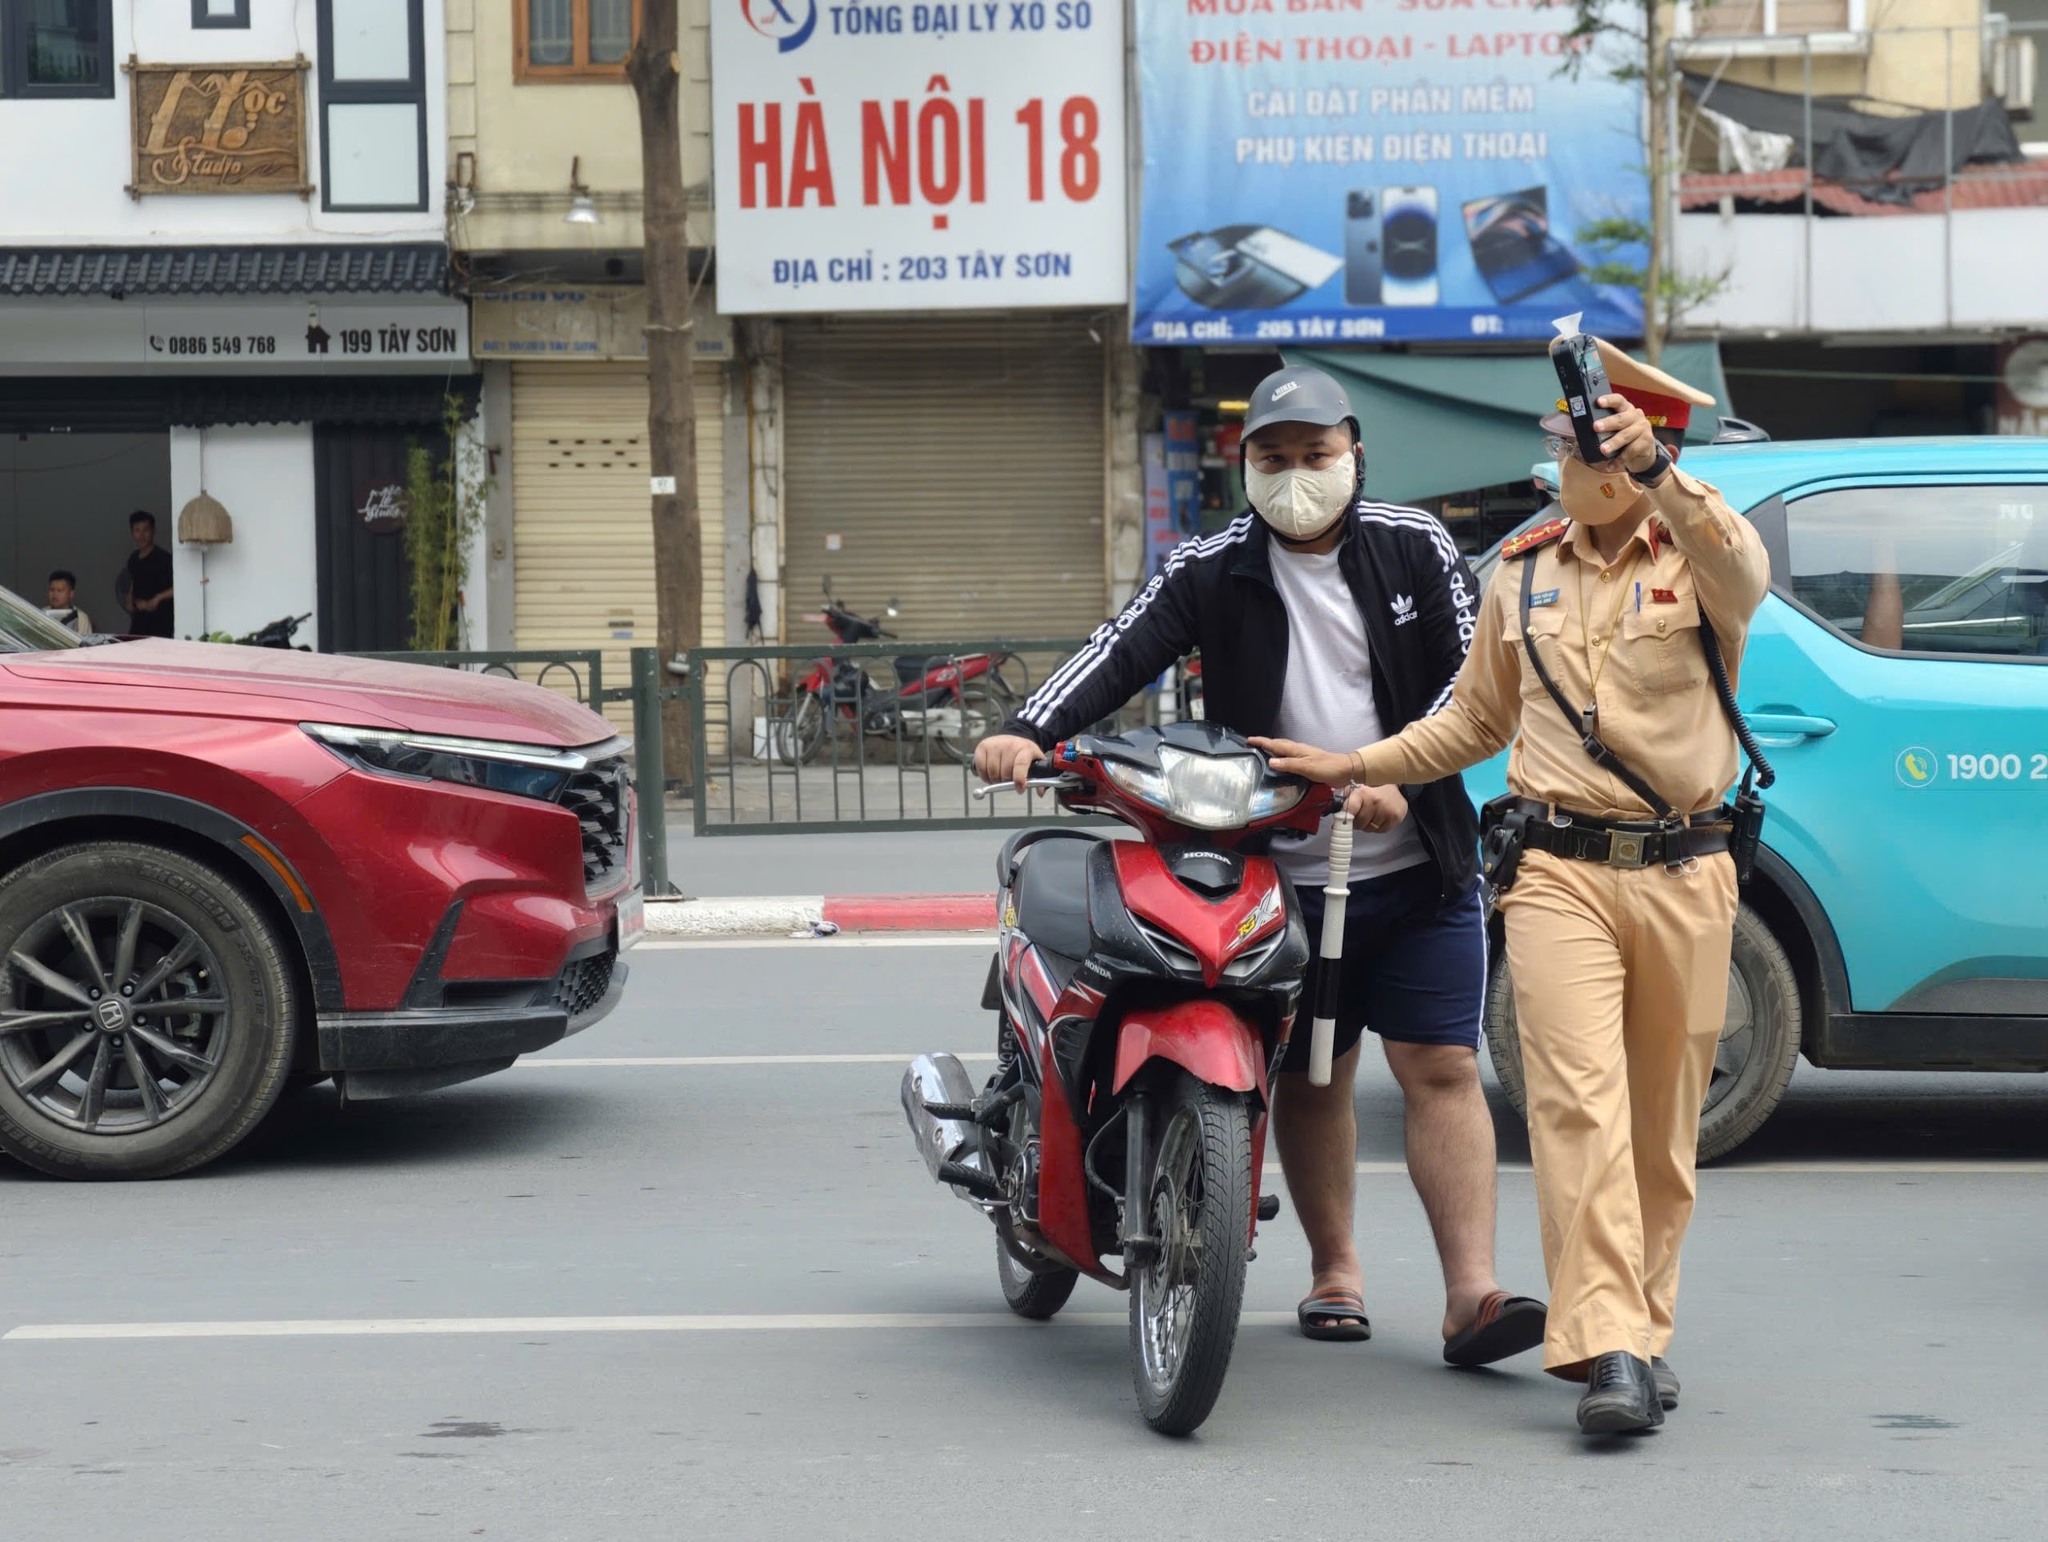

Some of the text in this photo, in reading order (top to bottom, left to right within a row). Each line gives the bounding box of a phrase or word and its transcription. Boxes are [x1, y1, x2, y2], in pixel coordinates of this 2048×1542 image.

[912, 4, 958, 40] ĐẠI
[1189, 32, 1283, 68] ĐIỆN
[1294, 35, 1413, 66] THOẠI
[152, 136, 242, 184] Studio
[738, 74, 1101, 230] HÀ NỘI 18
[1236, 137, 1296, 169] PHỤ
[1382, 130, 1452, 166] ĐIỆN
[1463, 132, 1547, 164] THOẠI
[773, 259, 819, 288] ĐỊA
[828, 250, 873, 282] CHỈ
[899, 257, 947, 281] 203
[958, 249, 1005, 279] TÂY
[1016, 251, 1072, 279] SƠN
[168, 335, 276, 355] 0886 549 768
[339, 329, 372, 354] 199
[378, 323, 411, 353] TÂY
[415, 326, 457, 353] SƠN
[1152, 319, 1189, 341] ĐỊA
[1298, 316, 1337, 338] TÂY
[1341, 316, 1384, 338] SƠN
[1115, 574, 1164, 632] didas
[1394, 610, 1418, 626] adidas
[1947, 753, 2048, 780] 1900 2
[1183, 851, 1232, 866] HONDA
[139, 863, 241, 933] MICHELIN
[1084, 958, 1113, 981] HONDA
